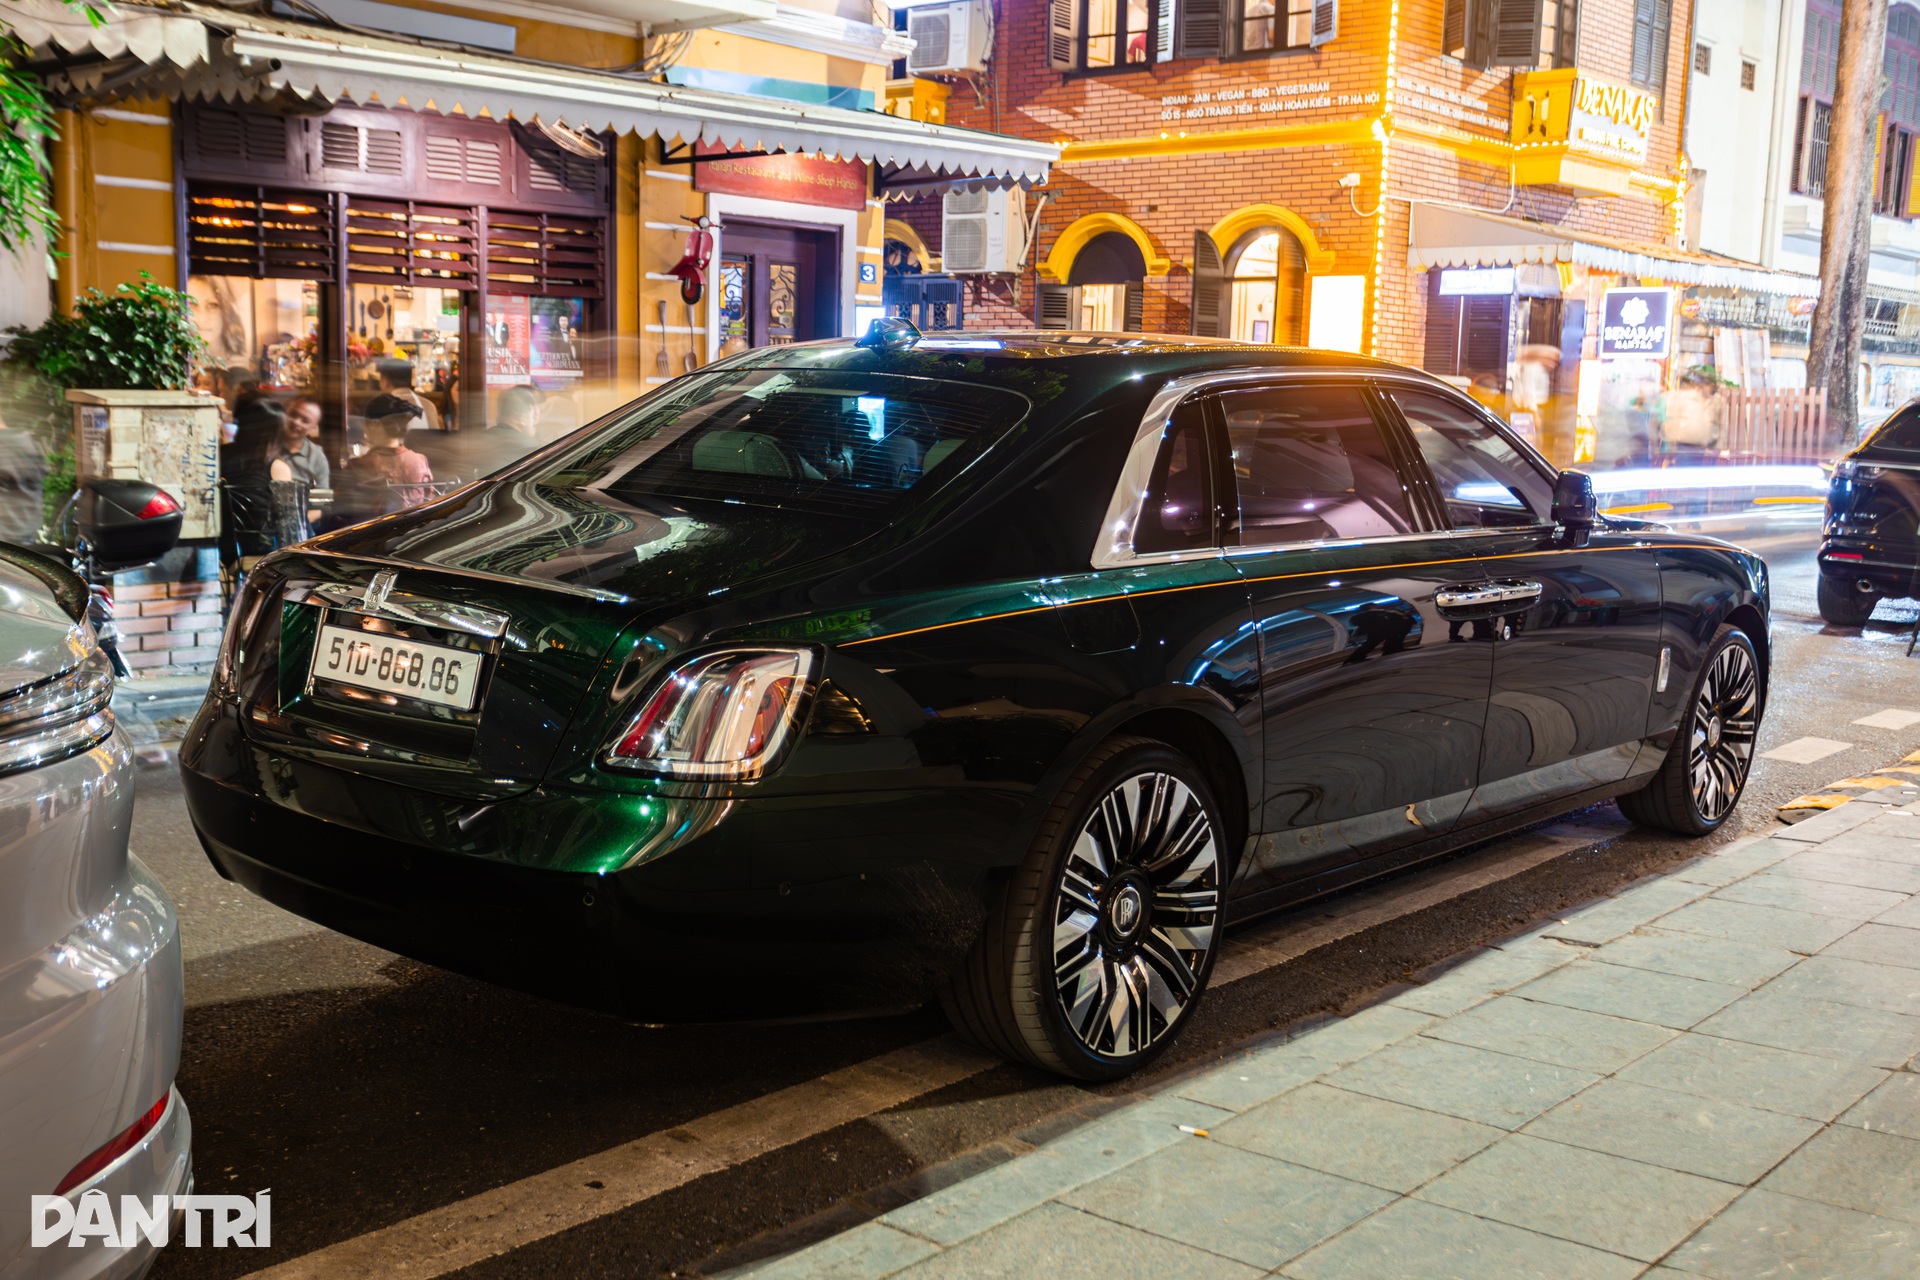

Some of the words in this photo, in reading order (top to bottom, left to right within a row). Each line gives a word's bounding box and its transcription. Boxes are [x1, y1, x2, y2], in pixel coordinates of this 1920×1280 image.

[1161, 94, 1187, 106] INDIAN
[1193, 92, 1210, 103] JAIN
[1217, 89, 1245, 101] VEGAN
[1252, 87, 1270, 98] BBQ
[1276, 82, 1331, 96] VEGETARIAN
[1205, 104, 1232, 117] TRÀNG
[1285, 97, 1308, 110] HOÀN
[1364, 91, 1380, 106] NỘI
[1577, 77, 1657, 136] BENARAS
[708, 160, 730, 173] Italian
[732, 162, 775, 179] Restaurant
[777, 168, 792, 182] and
[793, 171, 814, 185] Wine
[816, 173, 834, 190] Shop
[862, 265, 874, 281] 3
[484, 347, 513, 358] USIK
[500, 363, 526, 374] WIEN
